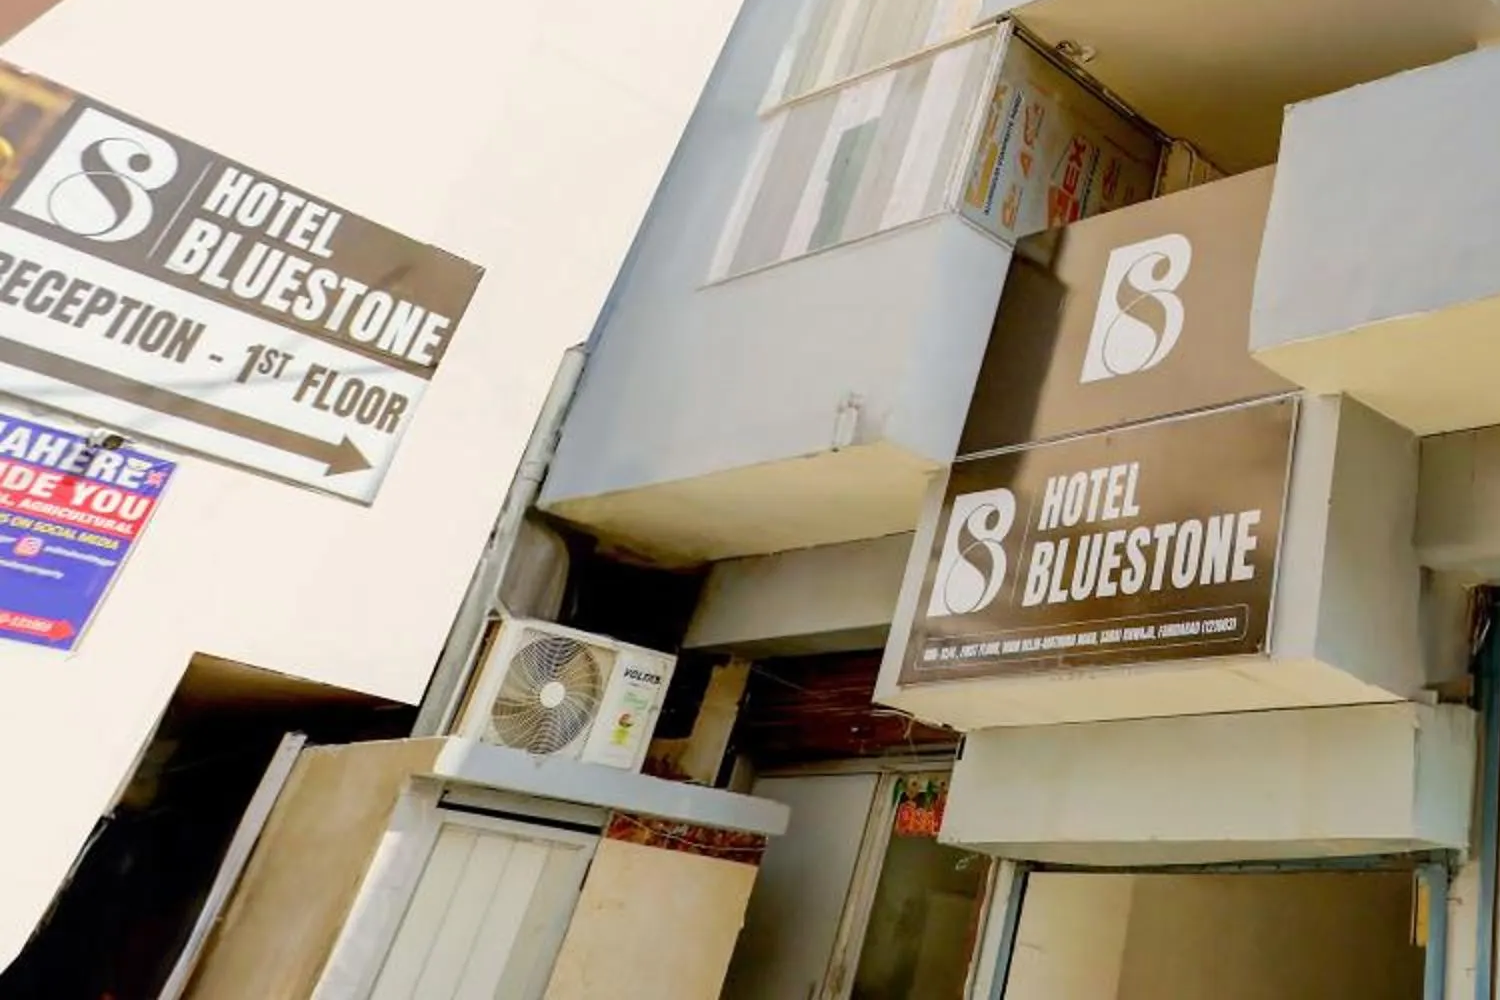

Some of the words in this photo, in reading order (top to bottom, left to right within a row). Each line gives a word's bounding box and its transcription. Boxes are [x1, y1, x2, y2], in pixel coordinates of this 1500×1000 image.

[203, 166, 343, 257] HOTEL
[165, 217, 452, 366] BLUESTONE
[235, 343, 294, 384] 1ST
[293, 364, 409, 434] FLOOR
[0, 421, 152, 488] AHERE
[1038, 462, 1140, 531] HOTEL
[69, 480, 152, 522] YOU
[1021, 509, 1261, 608] BLUESTONE
